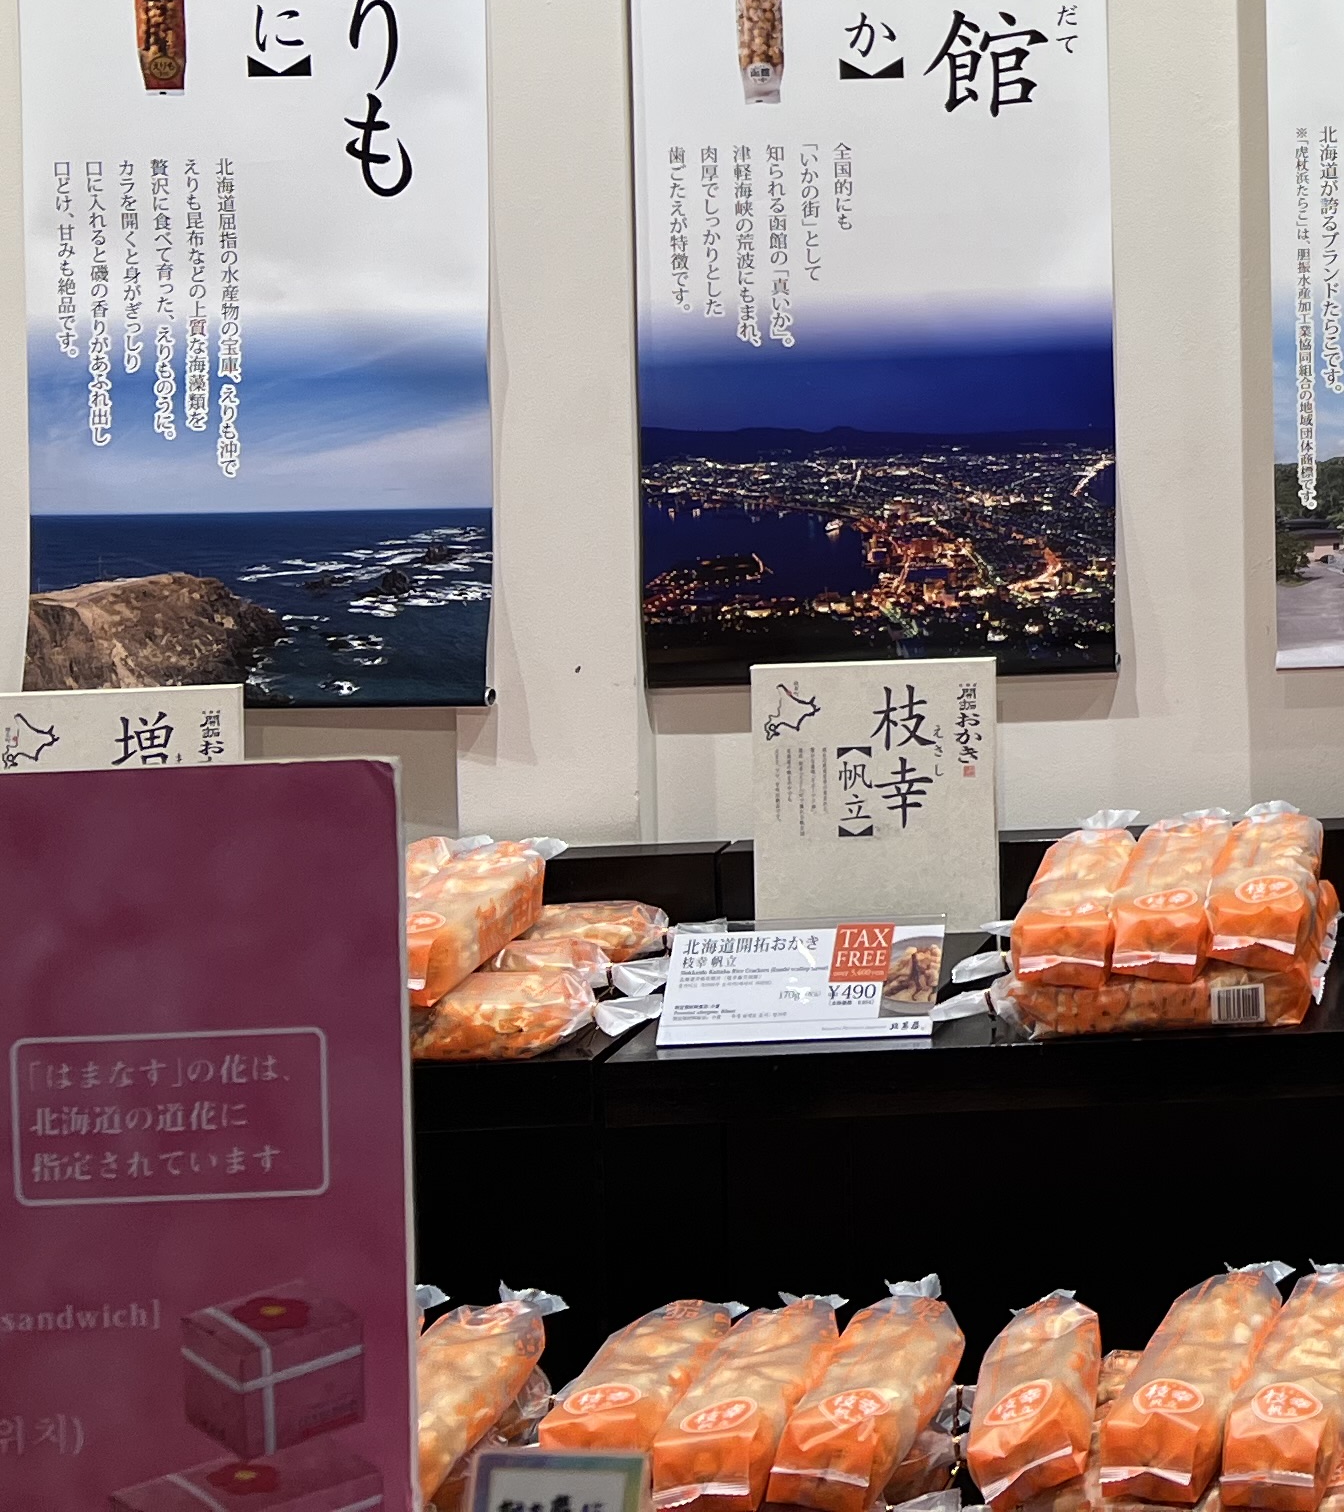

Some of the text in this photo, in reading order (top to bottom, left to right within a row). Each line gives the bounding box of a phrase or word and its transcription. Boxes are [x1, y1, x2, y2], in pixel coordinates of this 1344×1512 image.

[54, 160, 78, 357] 口どけ、甘みも絶品です。
[669, 147, 690, 312] 歯ごたえが特徴です。
[700, 146, 723, 317] 肉厚でしっかりとした
[733, 144, 760, 345] 津軽海峡の荒波にもまれ、
[766, 144, 795, 347] 知られる函館の「真いか」。
[800, 144, 821, 282] 「いかの街」として
[833, 142, 853, 231] 全国的にも
[1320, 125, 1344, 393] 北海道が誇るブランドたらこです。
[86, 160, 110, 443] 口に入れると磯の香りがあふれ出し
[118, 160, 141, 372] カラを開くと身がぎっしり
[150, 158, 176, 439] 贅沢に食べて育った、えりものうに。
[183, 158, 206, 428] えりも昆布などの上質な海藻類を
[215, 157, 242, 475] 北海道屈指の水産物の宝庫、えりも沖で
[837, 746, 873, 837] 【帆立】
[871, 685, 937, 828] 枝幸
[933, 725, 944, 776] えさし
[829, 984, 876, 999] ¥490
[836, 951, 887, 967] FREE
[840, 929, 891, 947] TAX
[29, 1055, 290, 1090] 「はまなす」の花は、
[30, 1102, 248, 1136] 北海道の道花に
[32, 1145, 279, 1181] 指定されています
